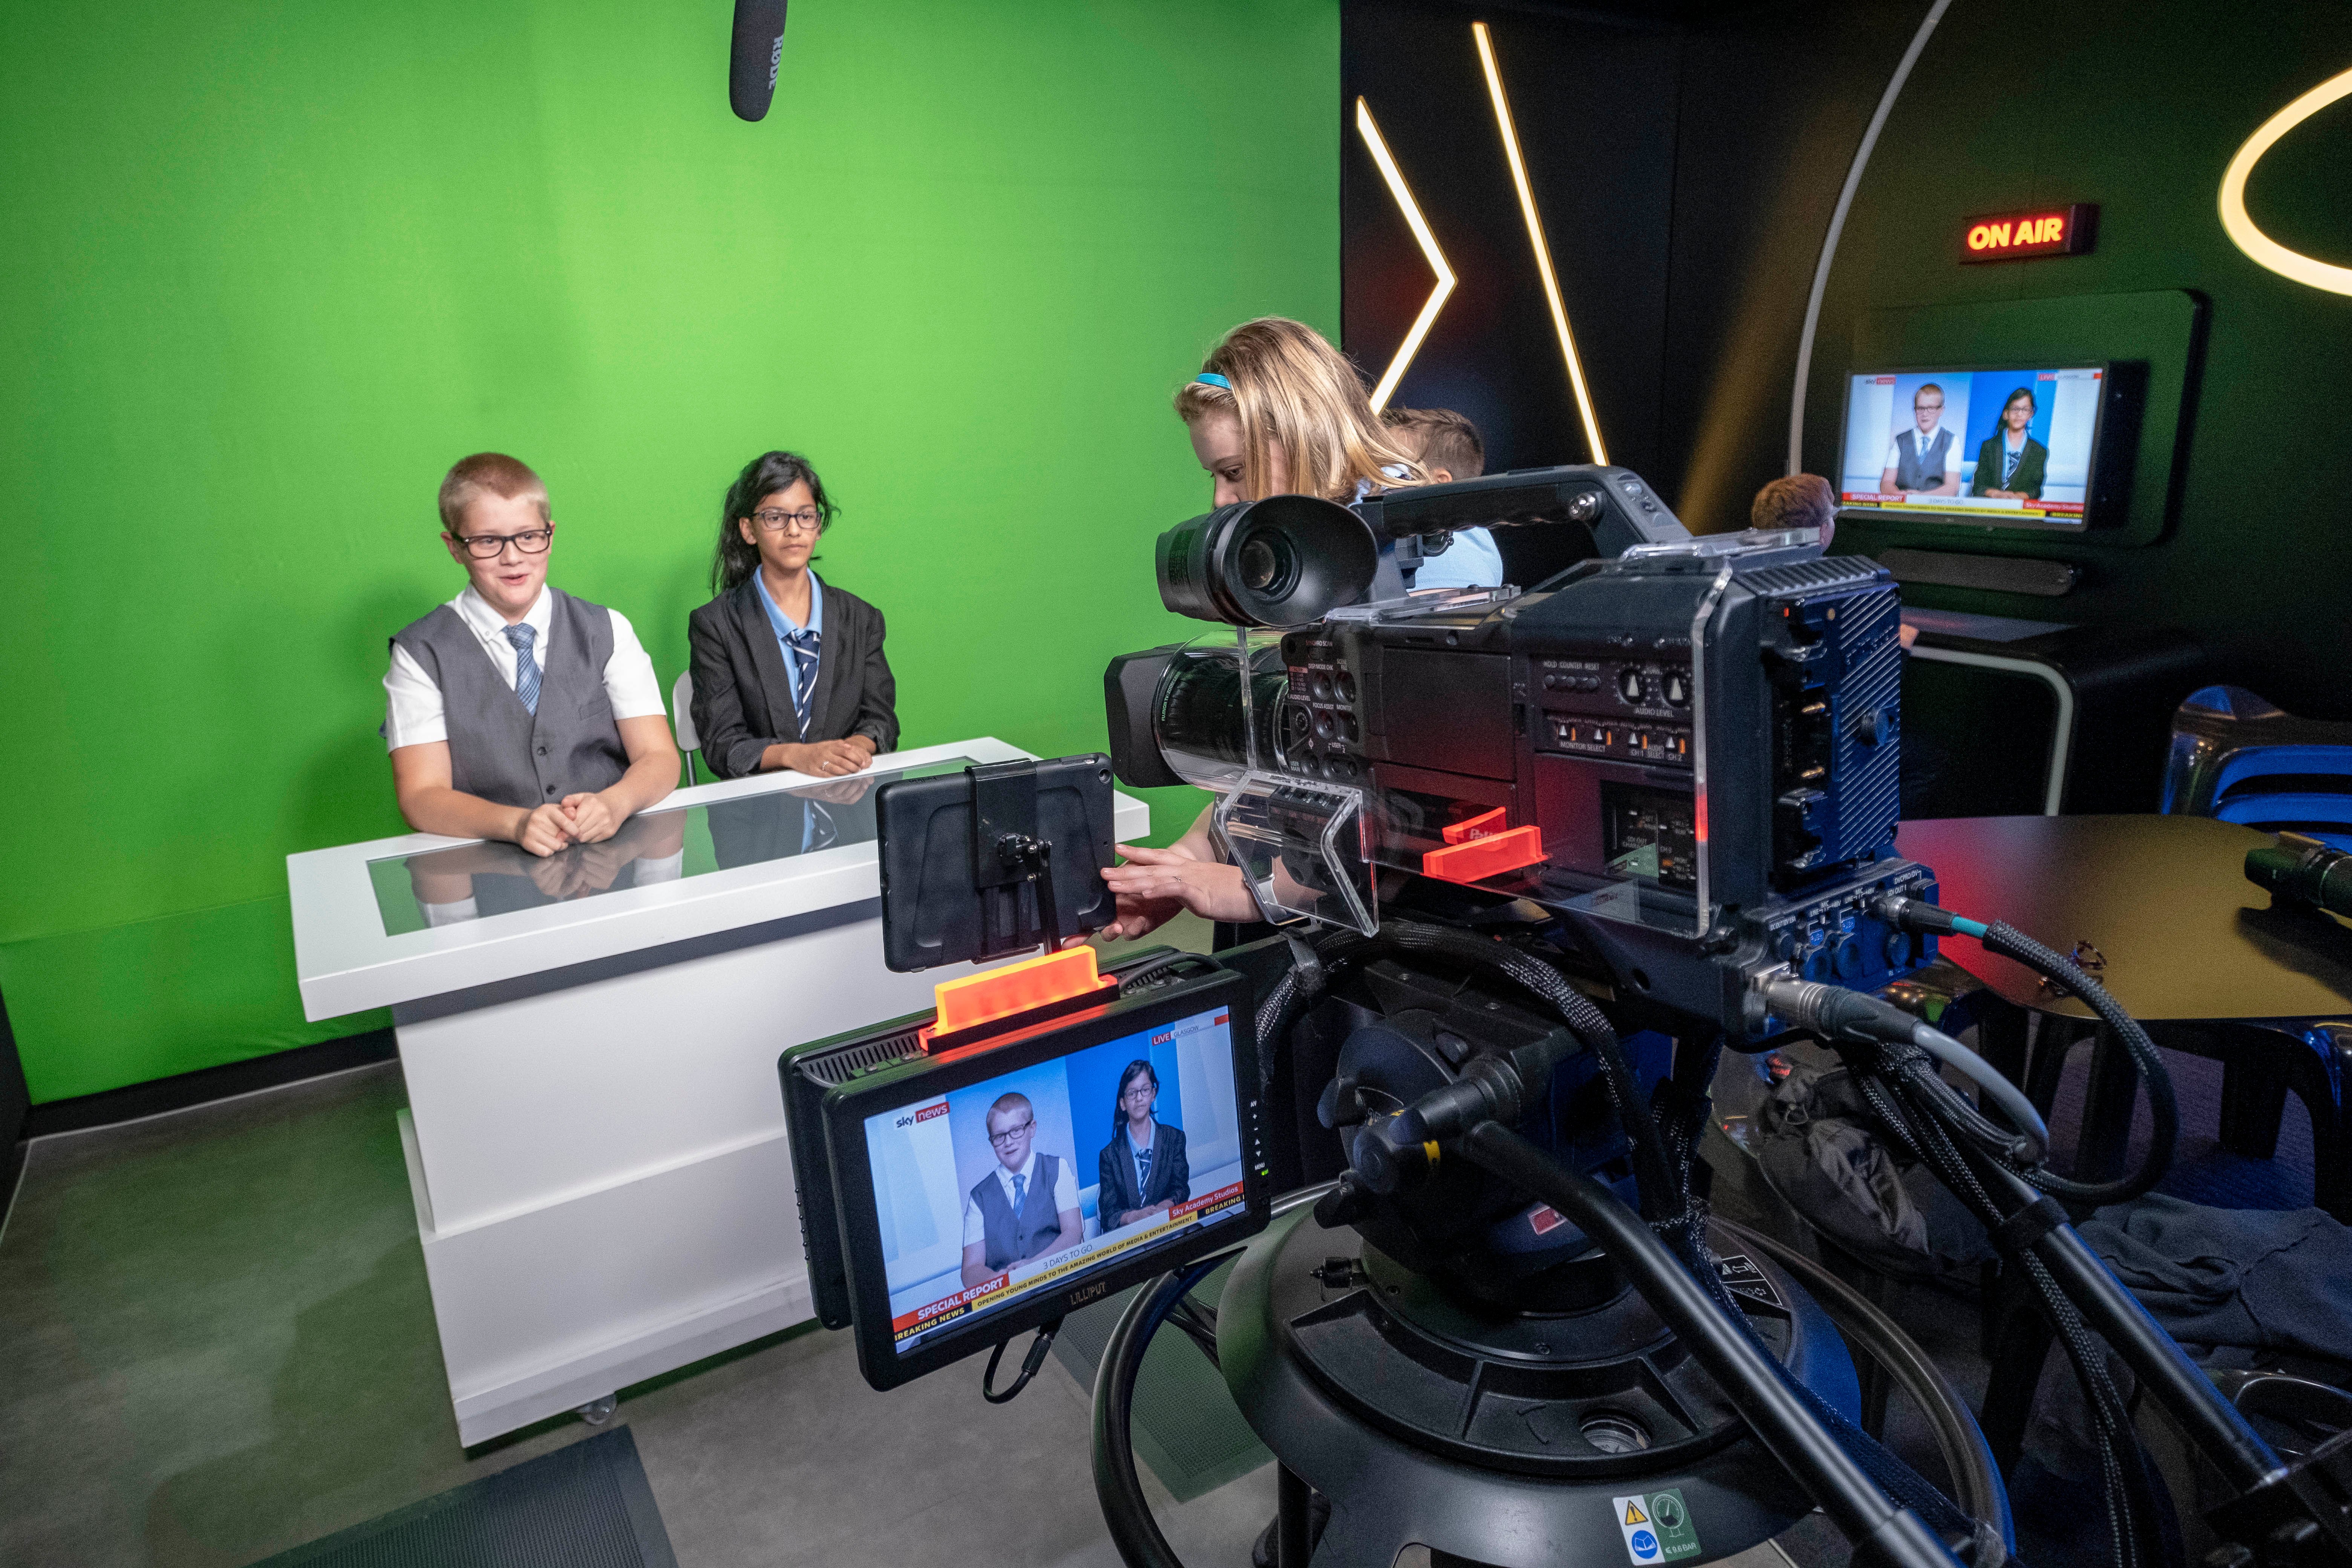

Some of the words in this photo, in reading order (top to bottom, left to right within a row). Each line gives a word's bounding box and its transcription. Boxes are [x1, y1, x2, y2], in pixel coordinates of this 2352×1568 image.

[1968, 223, 2011, 250] ON
[2013, 217, 2063, 245] AIR
[1559, 662, 1583, 670] COUNTER
[1585, 663, 1600, 671] RESET
[1634, 707, 1655, 716] AUDIO
[1656, 709, 1674, 718] LEVEL
[1559, 741, 1586, 750] MONITOR
[1587, 744, 1606, 753] SELECT
[1894, 870, 1918, 885] DVCPRO/DV
[1895, 885, 1904, 894] OUT
[1153, 1033, 1170, 1044] LIVE
[1174, 1025, 1199, 1037] GLASGOW
[896, 1116, 914, 1128] sky
[918, 1104, 948, 1121] news
[1172, 1208, 1184, 1217] Sky
[1185, 1196, 1213, 1212] Academy
[1214, 1186, 1238, 1200] Studios
[1205, 1196, 1241, 1215] BREAKING
[977, 1292, 1004, 1307] OPENING
[1006, 1283, 1027, 1295] YOUNG
[1028, 1275, 1047, 1286] MINDS
[1069, 1256, 1096, 1269] AMAZING
[1096, 1247, 1117, 1259] WORLD
[1126, 1236, 1143, 1246] MEDIA
[1149, 1216, 1193, 1237] ENTERTAINMENT
[1050, 1254, 1068, 1268] DAYS
[1070, 1250, 1080, 1259] TO
[1744, 1262, 1758, 1273] PUMP
[917, 1295, 962, 1320] SPECIAL
[962, 1277, 1004, 1302] REPORT
[1070, 1281, 1107, 1306] LILLIPUT
[939, 1307, 965, 1322] NEWS
[1682, 1542, 1697, 1551] BAR
